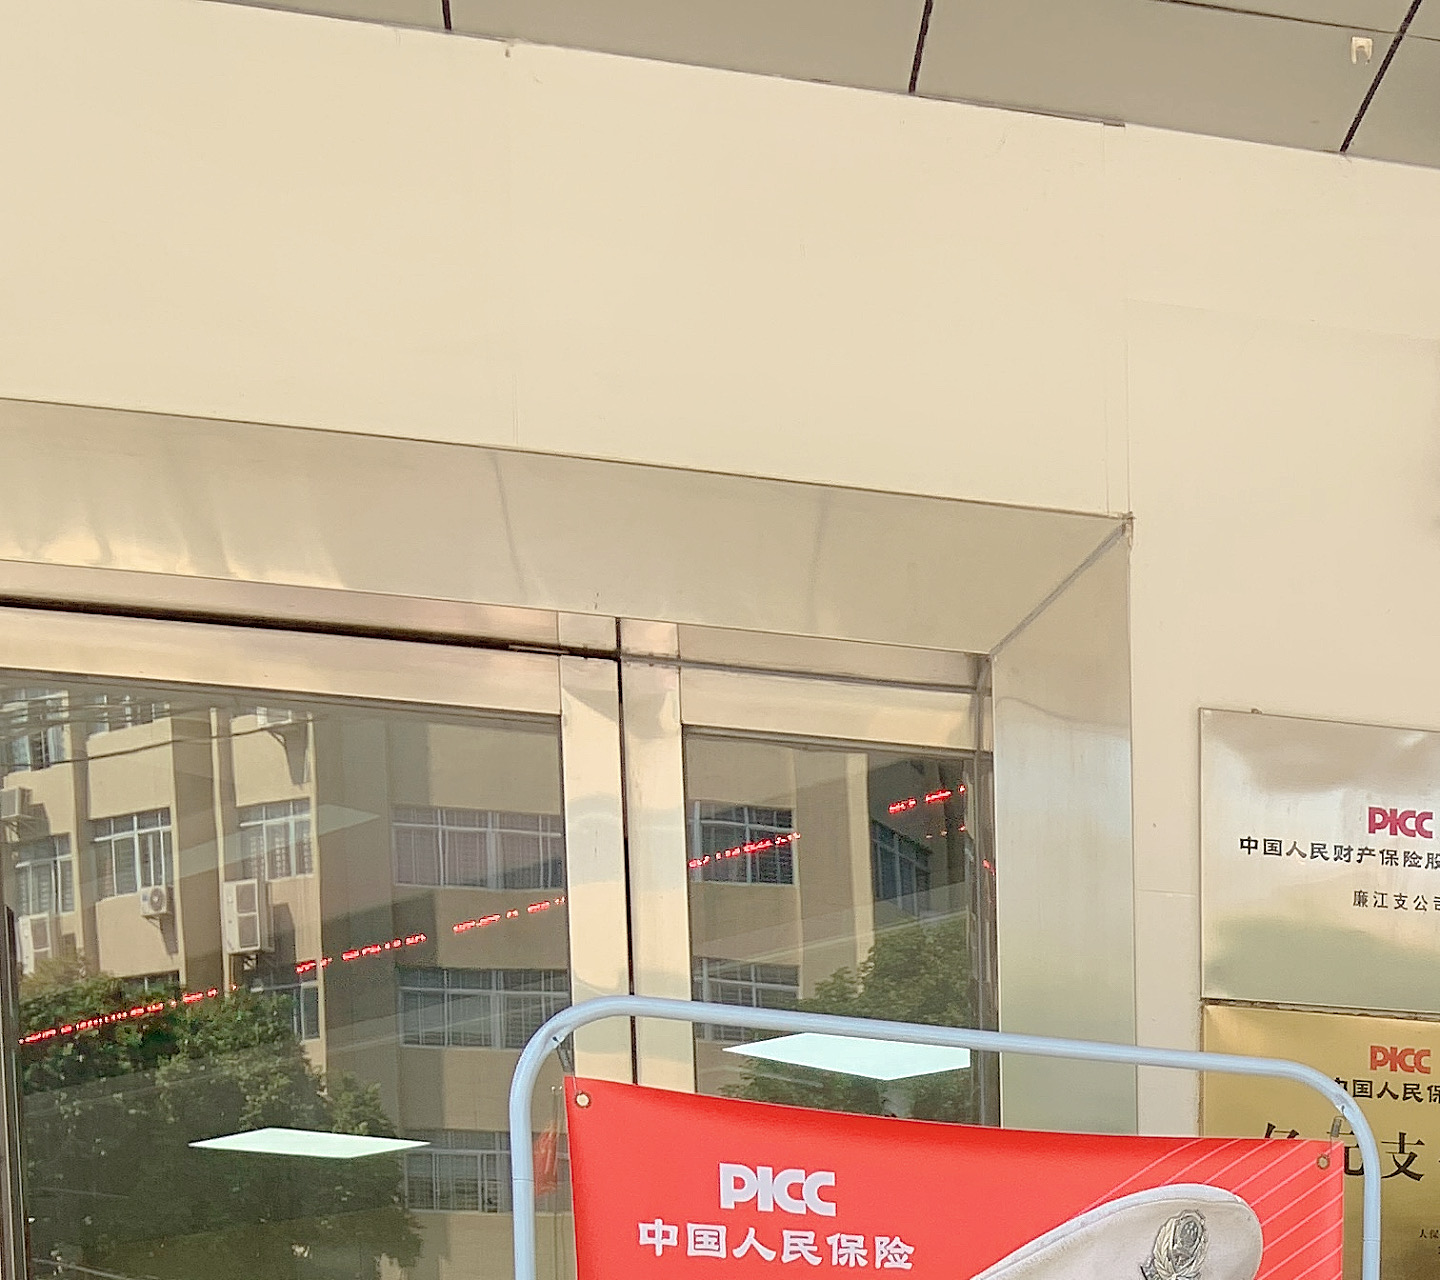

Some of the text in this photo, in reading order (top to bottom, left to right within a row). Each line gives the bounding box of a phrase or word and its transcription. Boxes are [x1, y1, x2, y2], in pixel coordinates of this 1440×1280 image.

[1368, 806, 1434, 839] PICC
[1369, 1045, 1432, 1075] PICC
[719, 1162, 837, 1217] PICC
[637, 1218, 915, 1270] 中国人民保险
